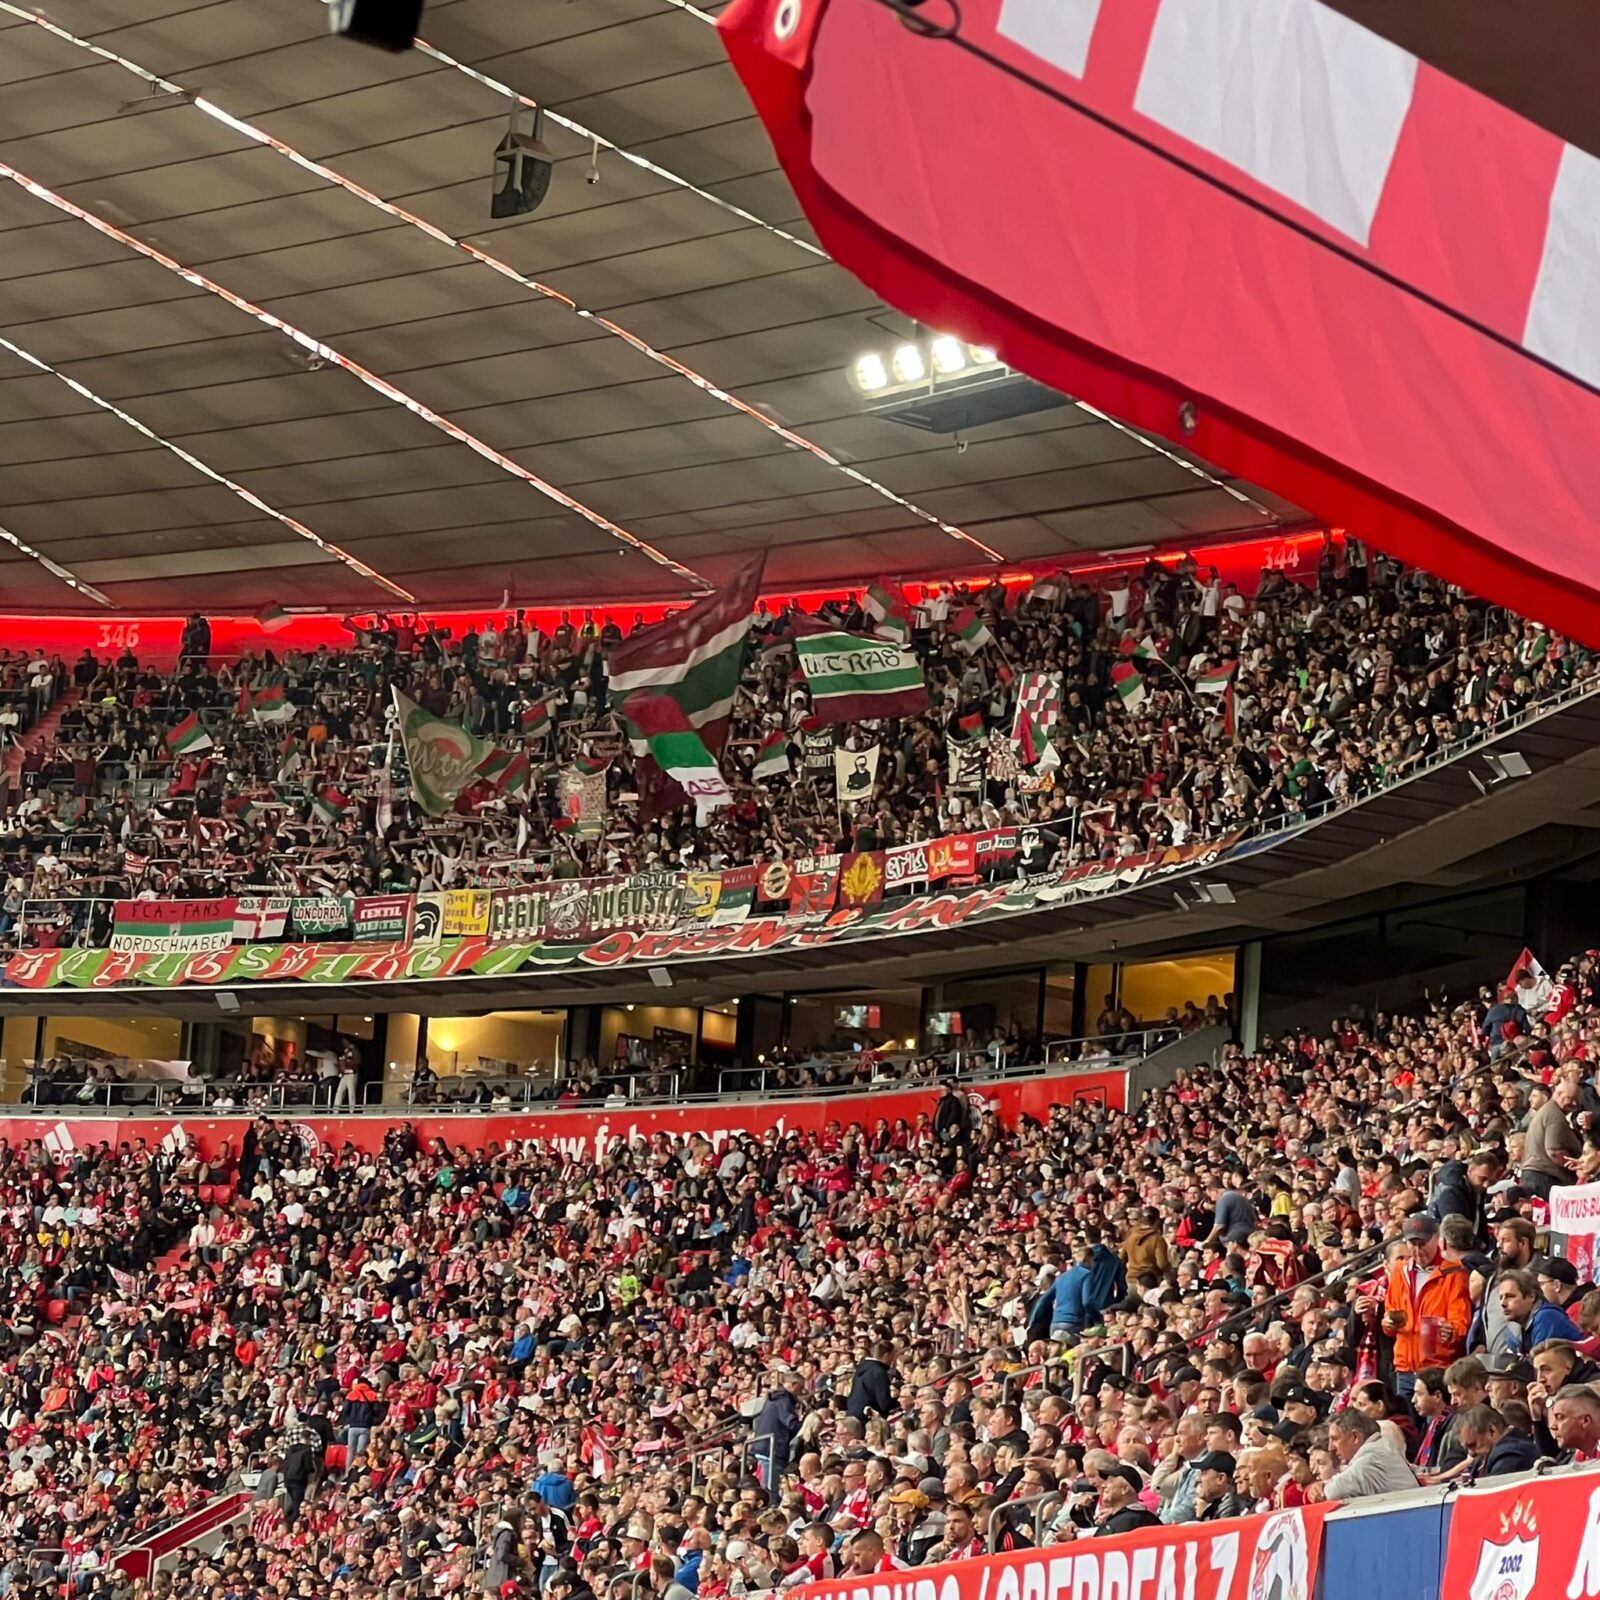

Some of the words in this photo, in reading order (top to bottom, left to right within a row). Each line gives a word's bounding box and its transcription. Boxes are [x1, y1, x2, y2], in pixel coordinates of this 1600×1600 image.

[1260, 545, 1300, 570] 344
[96, 624, 140, 649] 346
[132, 903, 163, 918] FCA
[182, 901, 221, 918] FANS
[292, 906, 347, 921] CONCORDIA
[113, 934, 229, 954] NORDSCHWABEN
[1498, 1553, 1523, 1575] 2002
